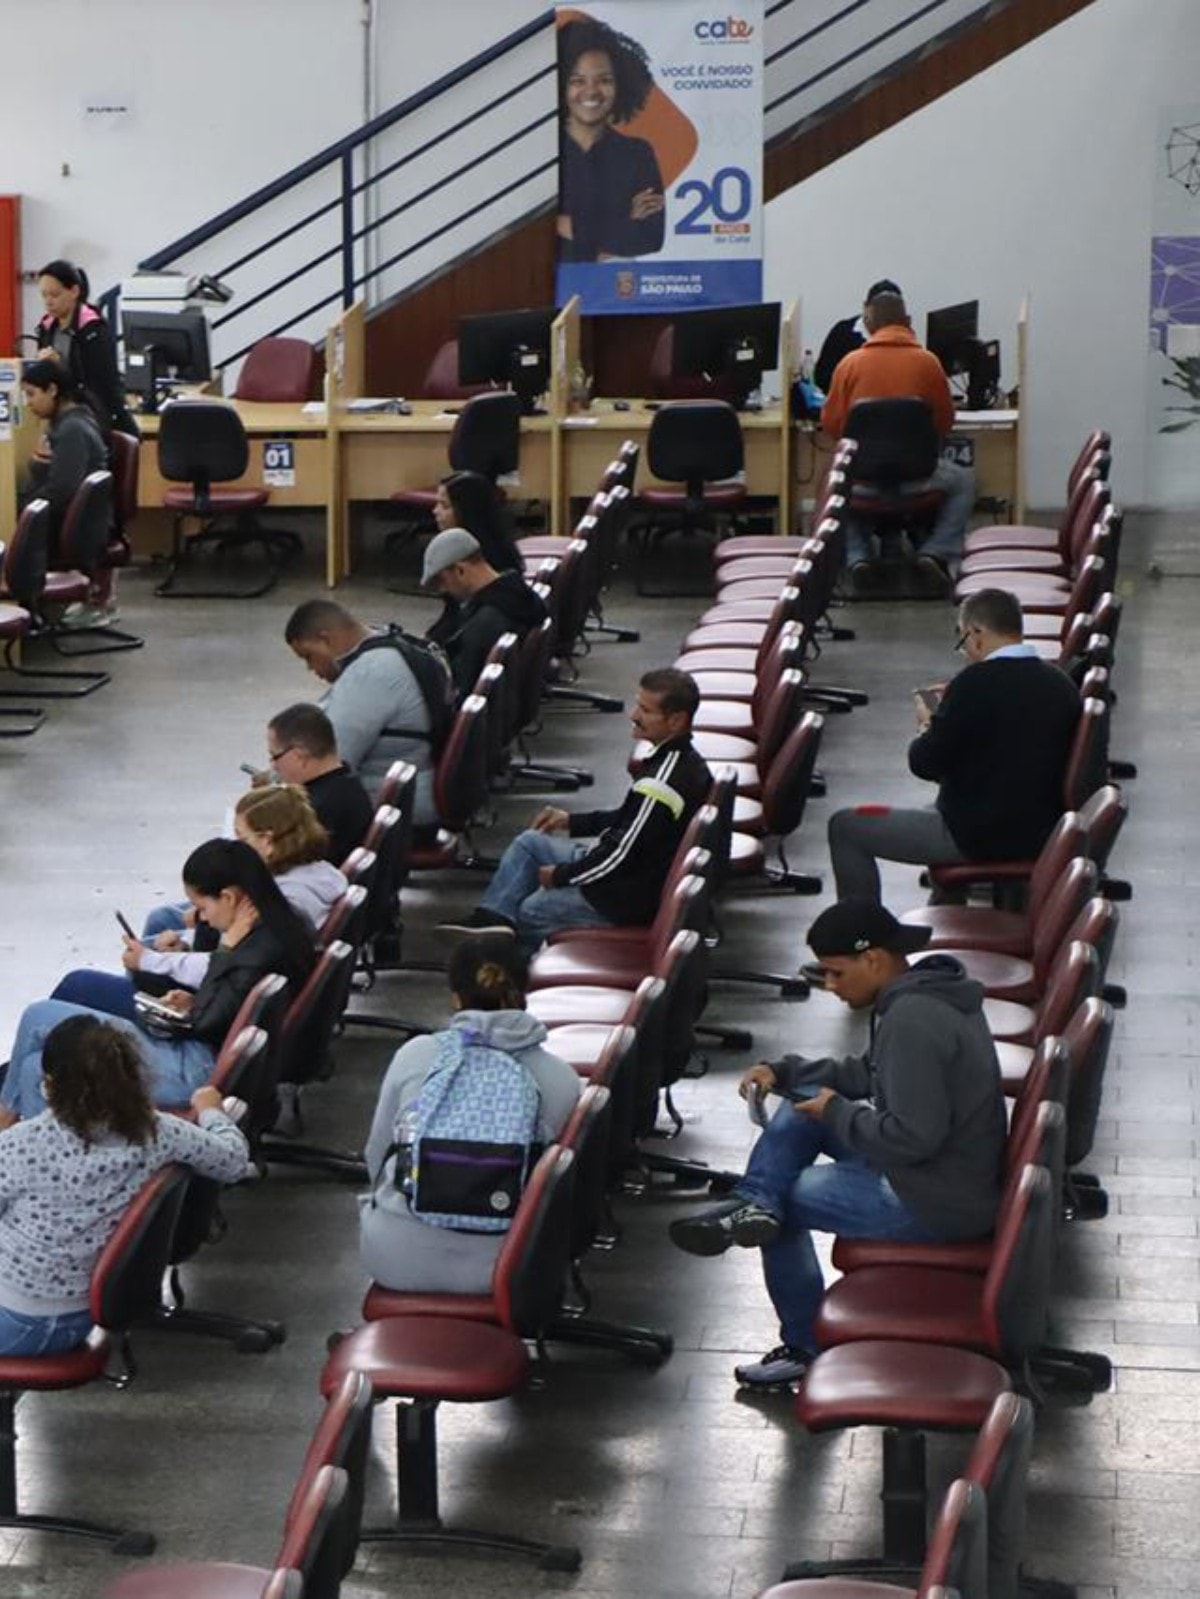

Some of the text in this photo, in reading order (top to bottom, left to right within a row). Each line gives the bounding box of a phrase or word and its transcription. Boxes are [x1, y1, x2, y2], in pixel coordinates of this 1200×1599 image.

[695, 16, 753, 38] cate
[674, 167, 751, 235] 20
[641, 283, 703, 295] SÃO PAULO
[265, 450, 290, 466] 01
